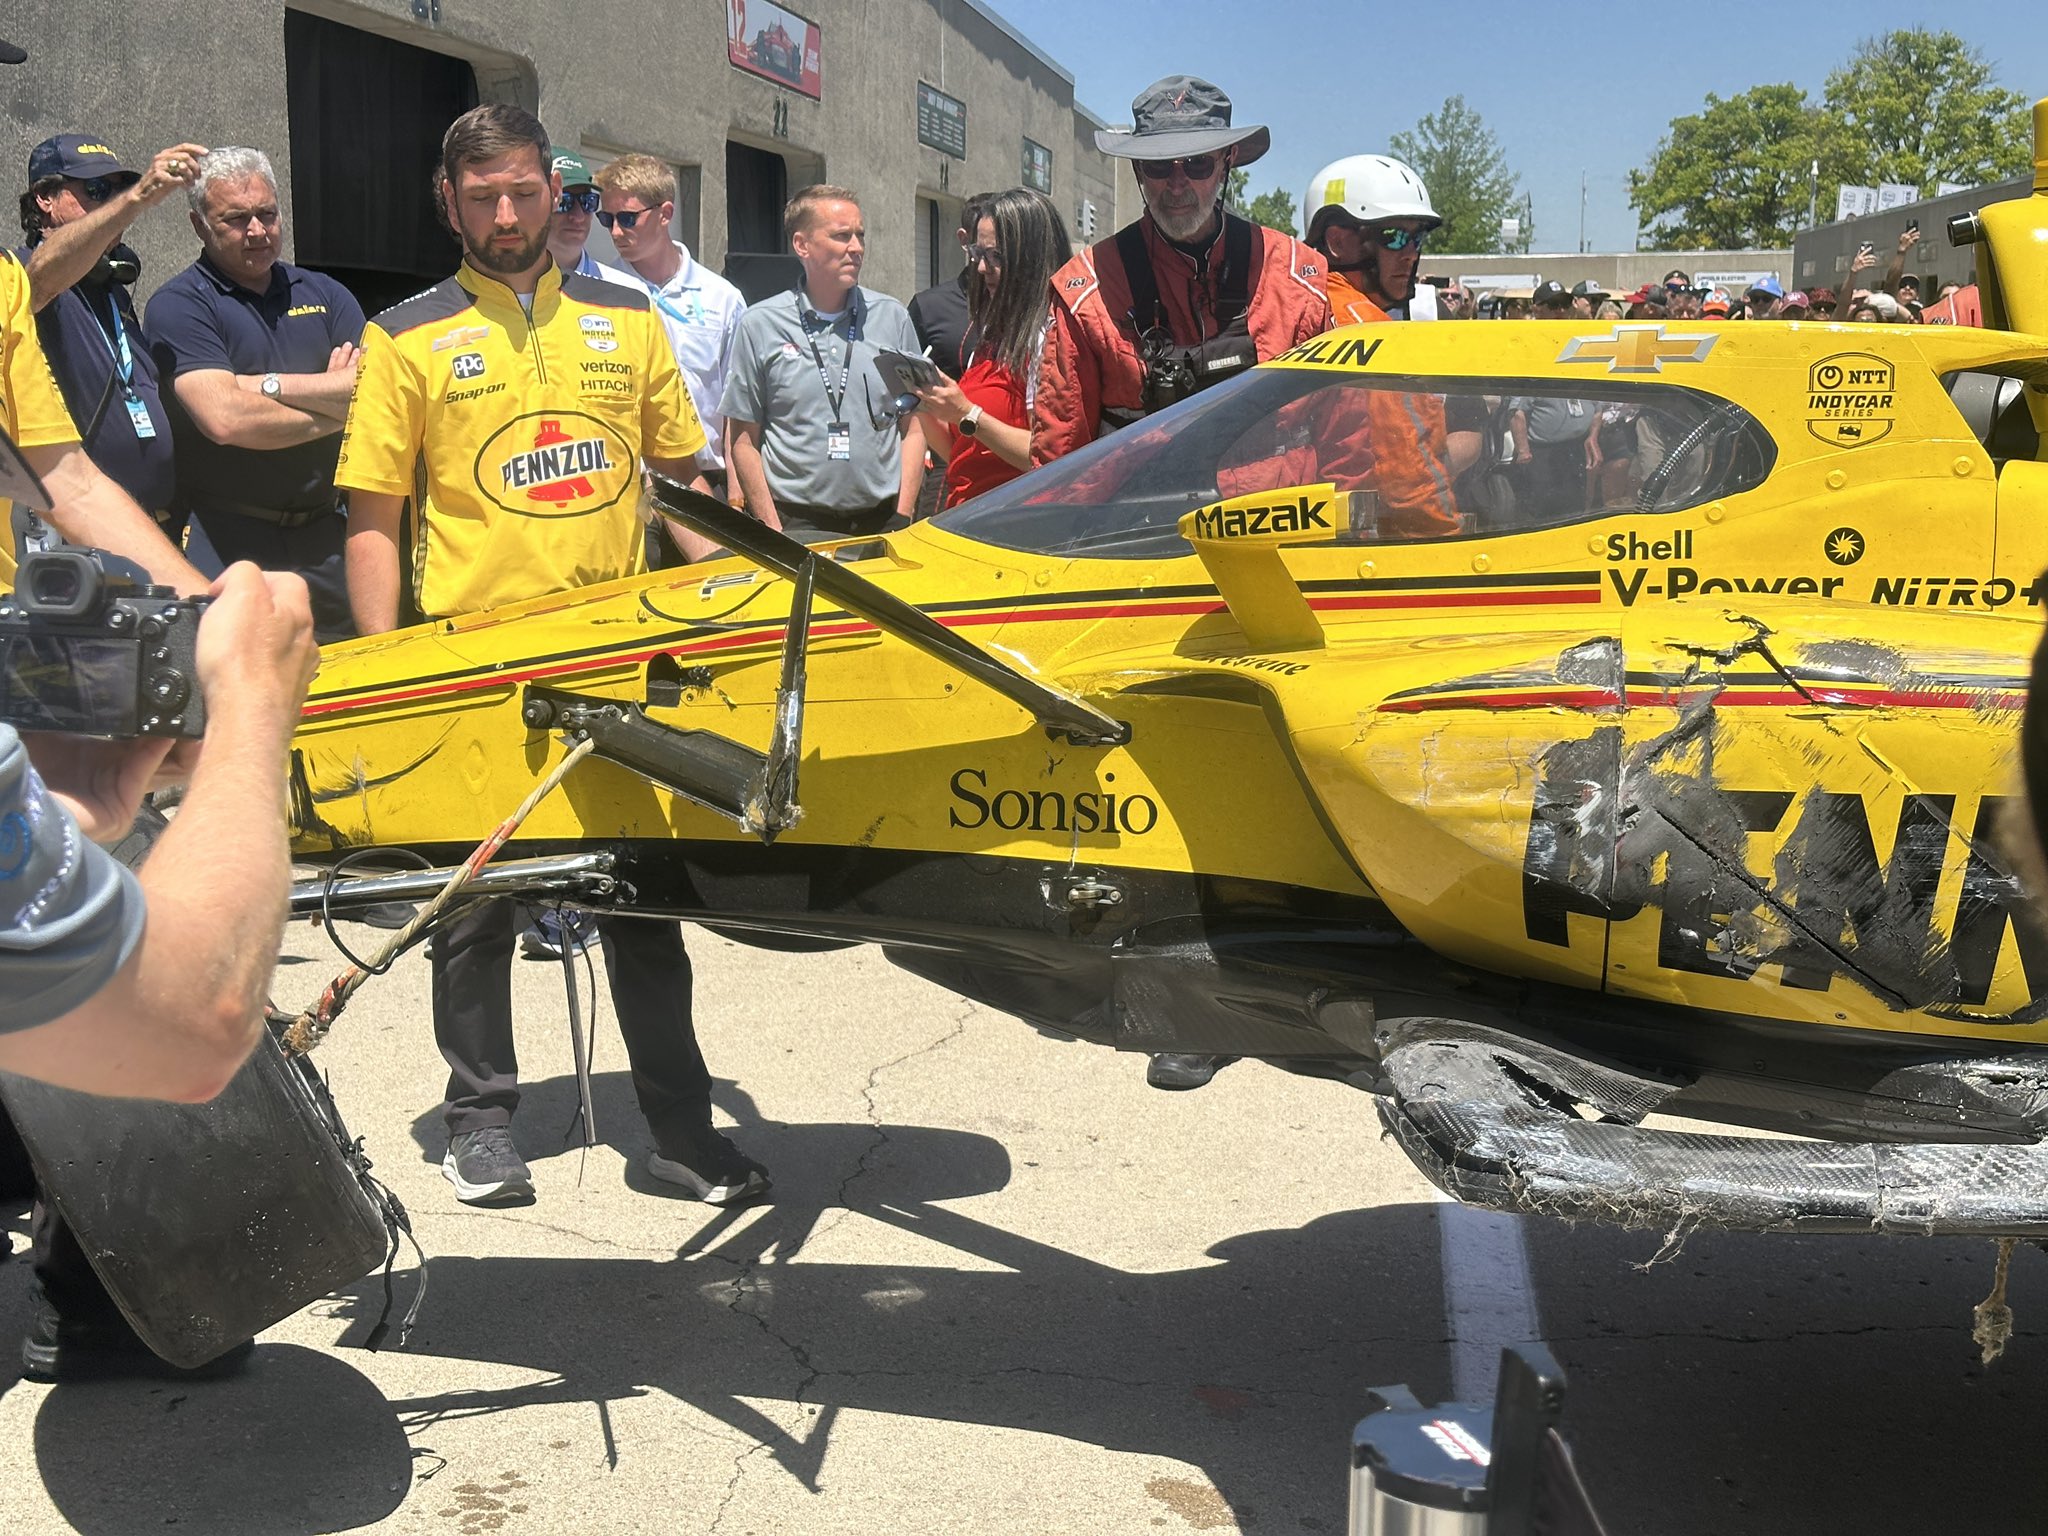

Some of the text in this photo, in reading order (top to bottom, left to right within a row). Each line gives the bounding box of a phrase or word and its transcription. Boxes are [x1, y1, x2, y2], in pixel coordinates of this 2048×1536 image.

[453, 355, 484, 377] PPG
[580, 360, 633, 376] verizon
[1848, 369, 1887, 385] NTT
[445, 382, 507, 405] Snap-on
[1808, 395, 1893, 409] INDYCAR
[1824, 408, 1874, 417] SERIES
[1194, 496, 1332, 539] Mazak
[1606, 529, 1693, 562] Shell
[1607, 566, 1844, 607] V-Power
[949, 768, 1159, 836] Sonsio
